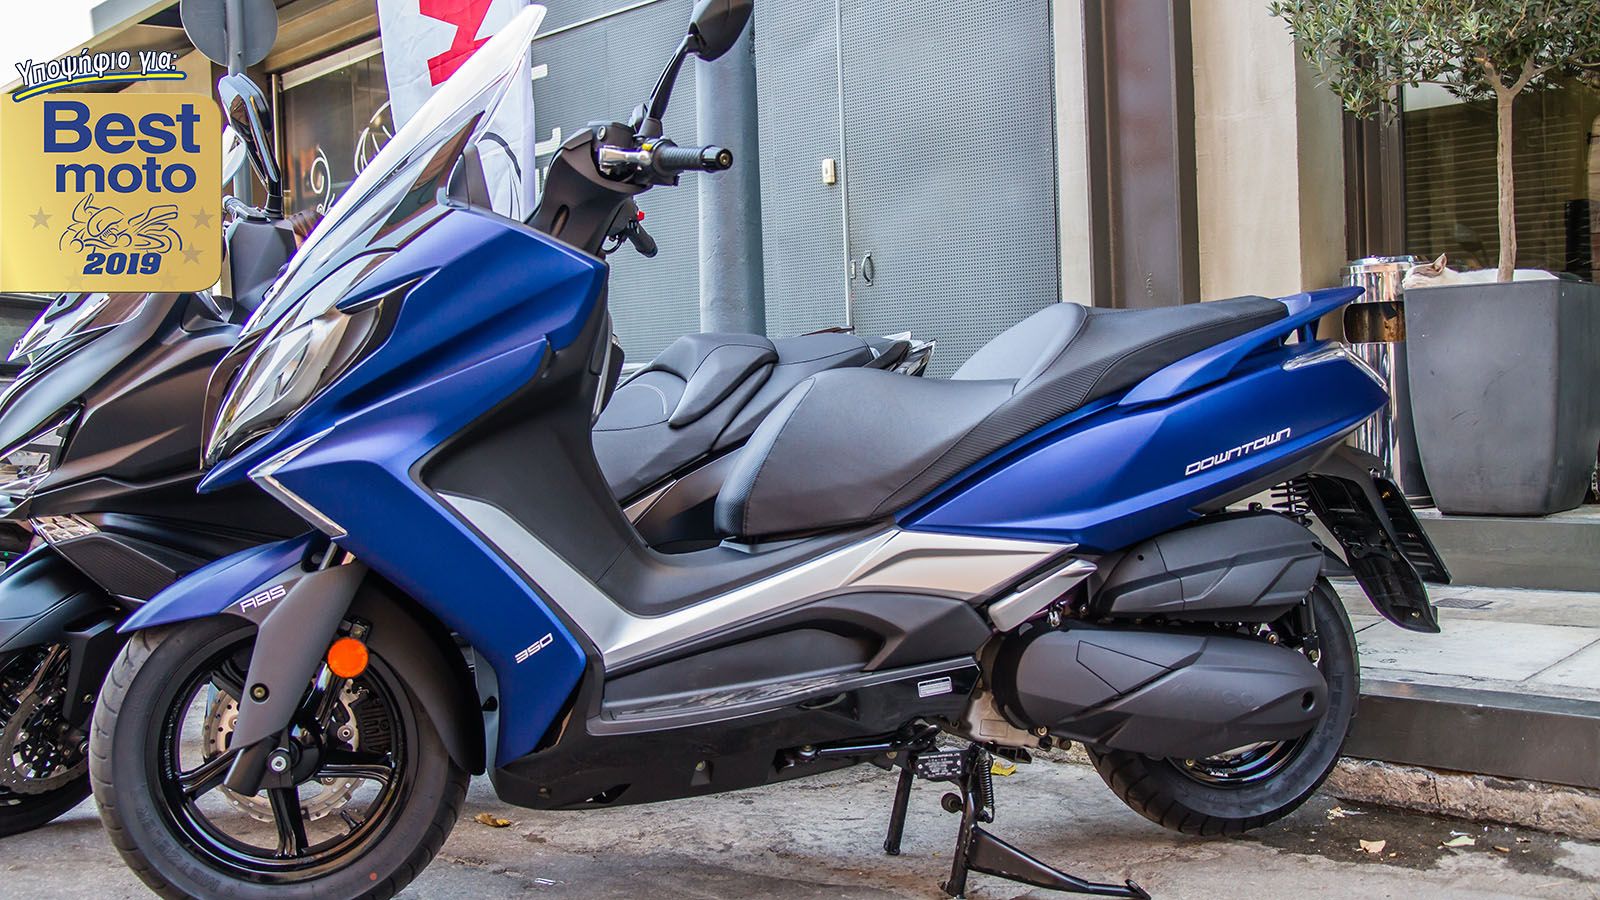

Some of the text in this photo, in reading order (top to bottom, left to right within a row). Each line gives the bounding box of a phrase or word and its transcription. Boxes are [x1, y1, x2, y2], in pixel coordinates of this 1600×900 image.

[1184, 427, 1291, 476] DOWNTOWN
[239, 584, 287, 613] ABS
[514, 632, 554, 664] 350
